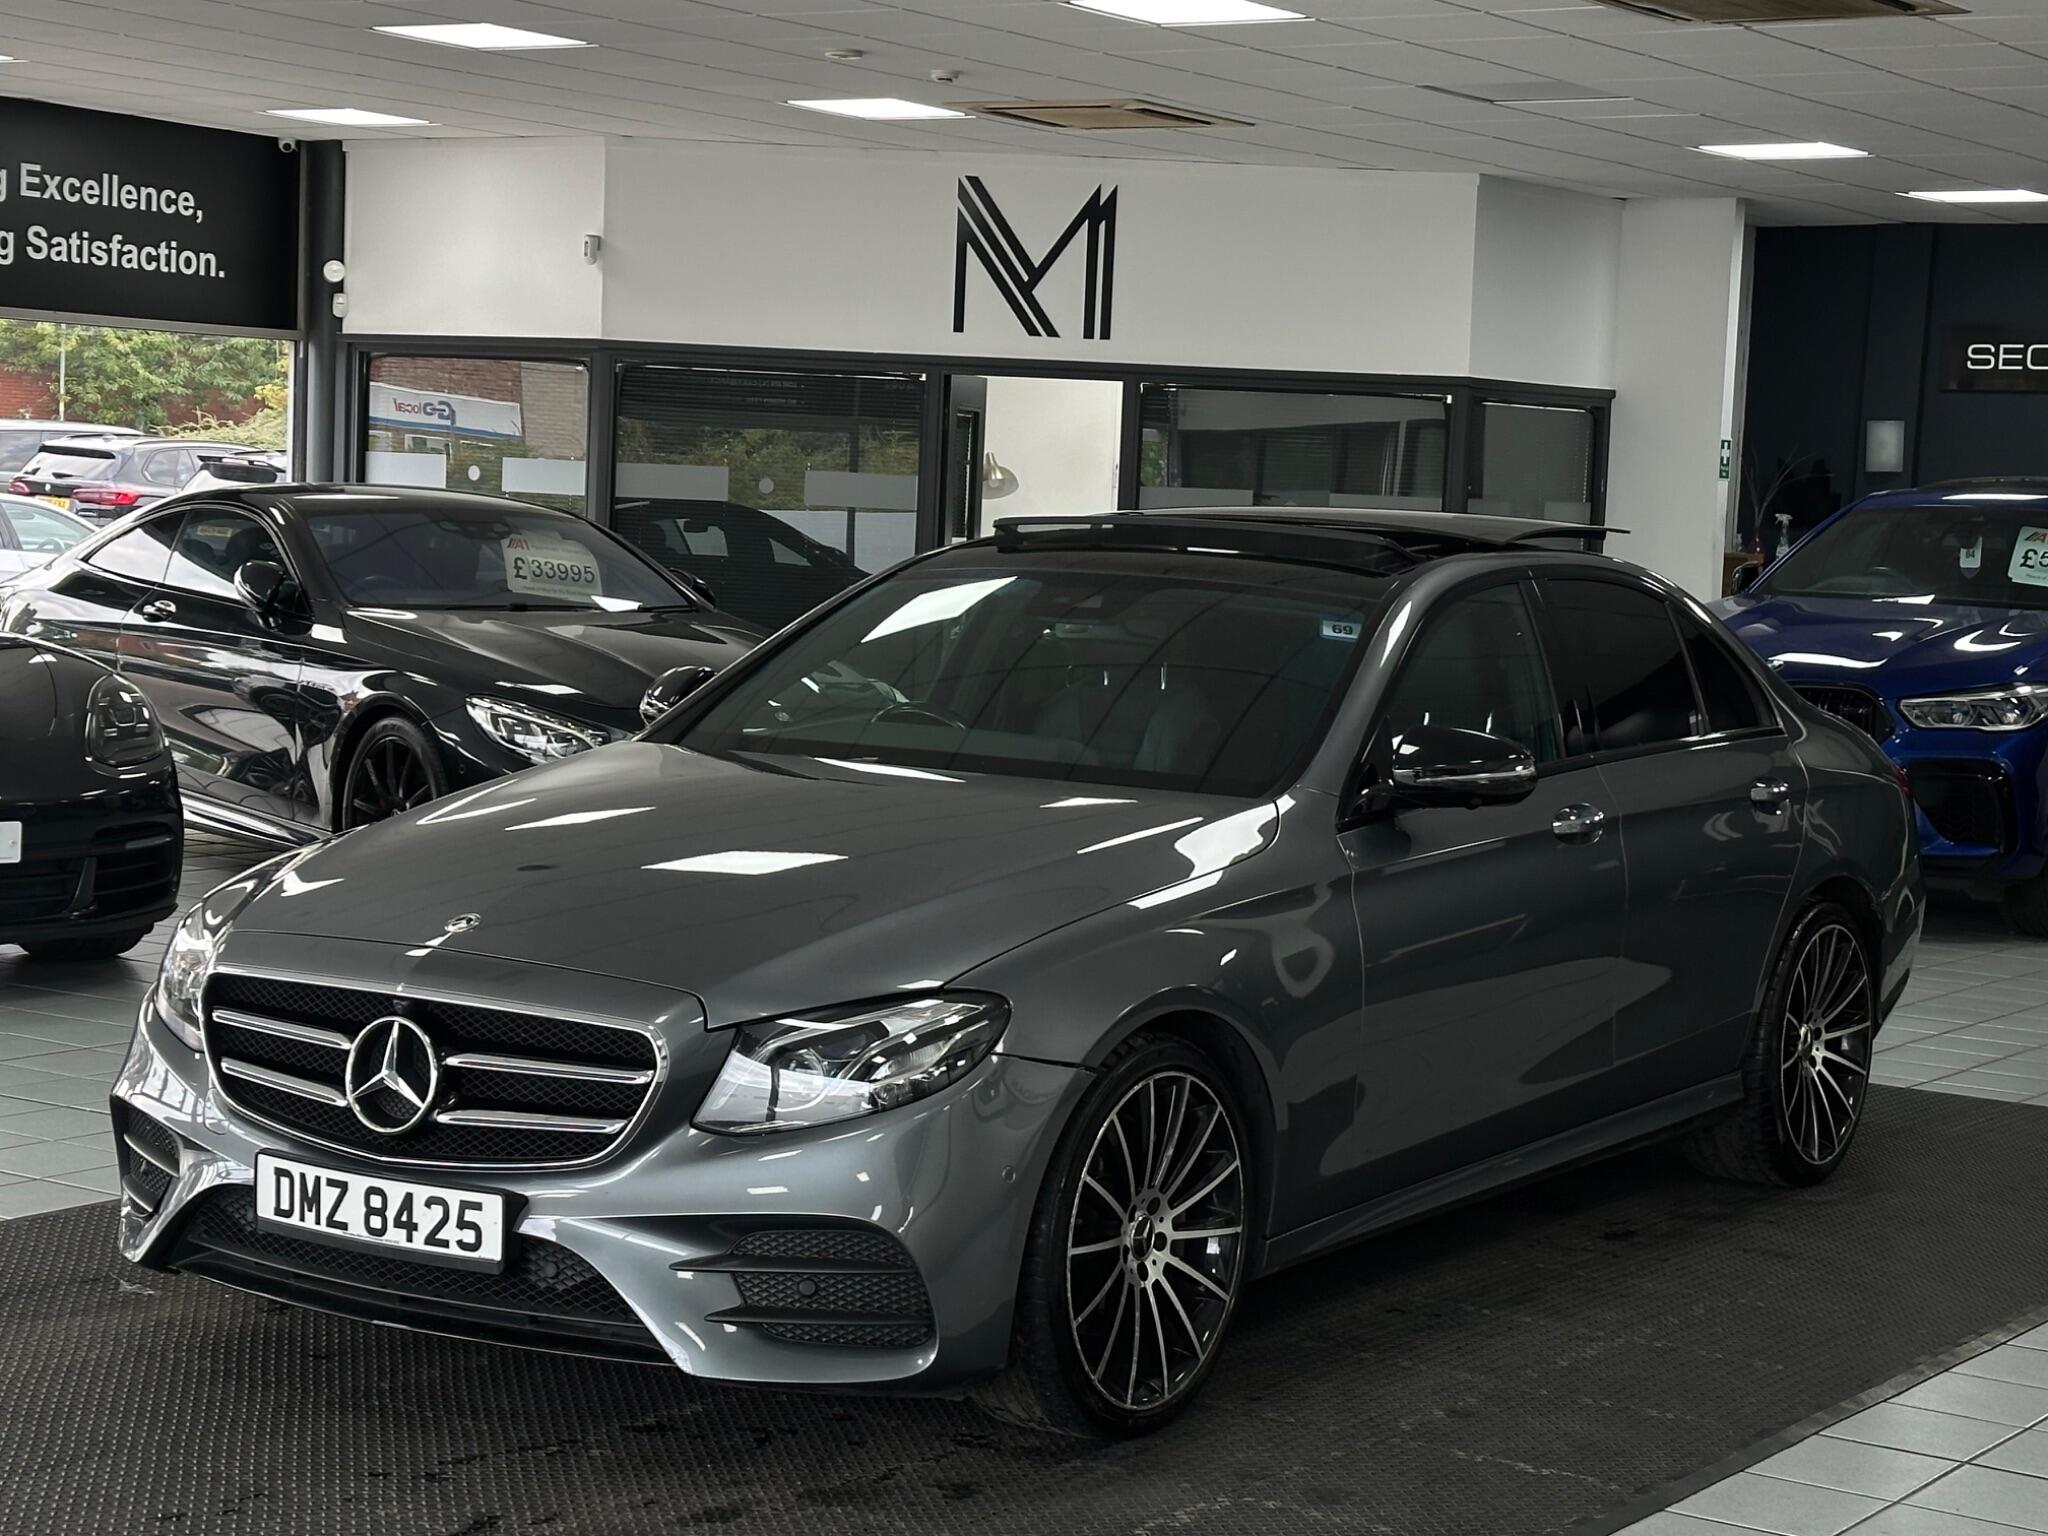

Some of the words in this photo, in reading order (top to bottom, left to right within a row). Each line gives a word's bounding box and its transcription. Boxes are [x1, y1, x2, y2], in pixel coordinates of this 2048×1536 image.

[20, 162, 203, 223] Excellence,
[26, 225, 225, 278] Satisfaction.
[513, 557, 596, 584] £33995
[2020, 548, 2048, 569] £5
[1332, 624, 1354, 635] 69
[274, 1167, 349, 1231] DMZ
[363, 1186, 483, 1252] 8425
